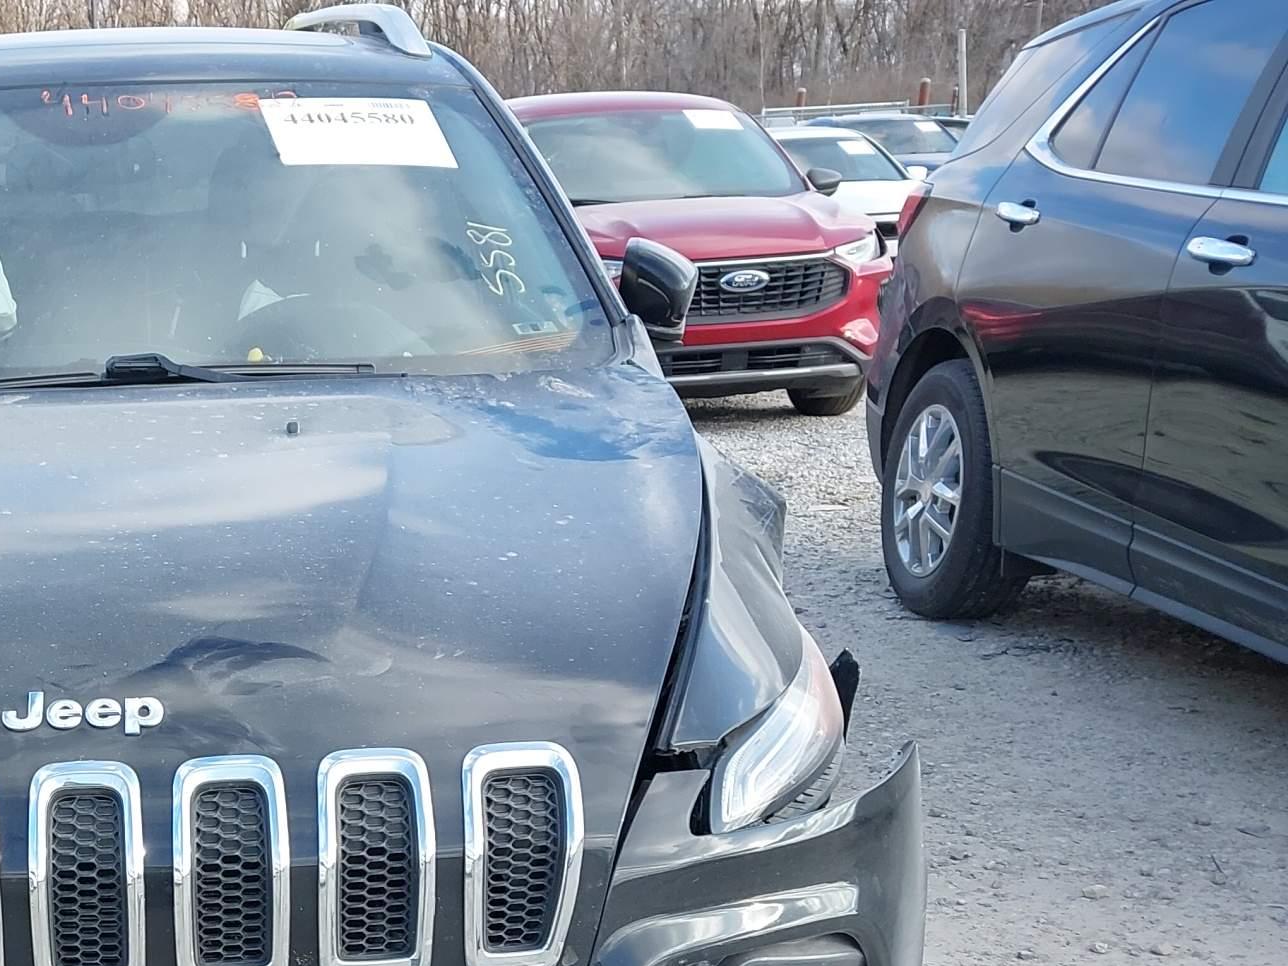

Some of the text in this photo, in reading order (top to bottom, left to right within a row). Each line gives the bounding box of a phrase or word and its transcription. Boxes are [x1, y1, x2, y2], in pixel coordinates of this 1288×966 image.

[283, 111, 416, 125] 44045580
[466, 221, 526, 296] 5581
[2, 691, 165, 736] Jeep
